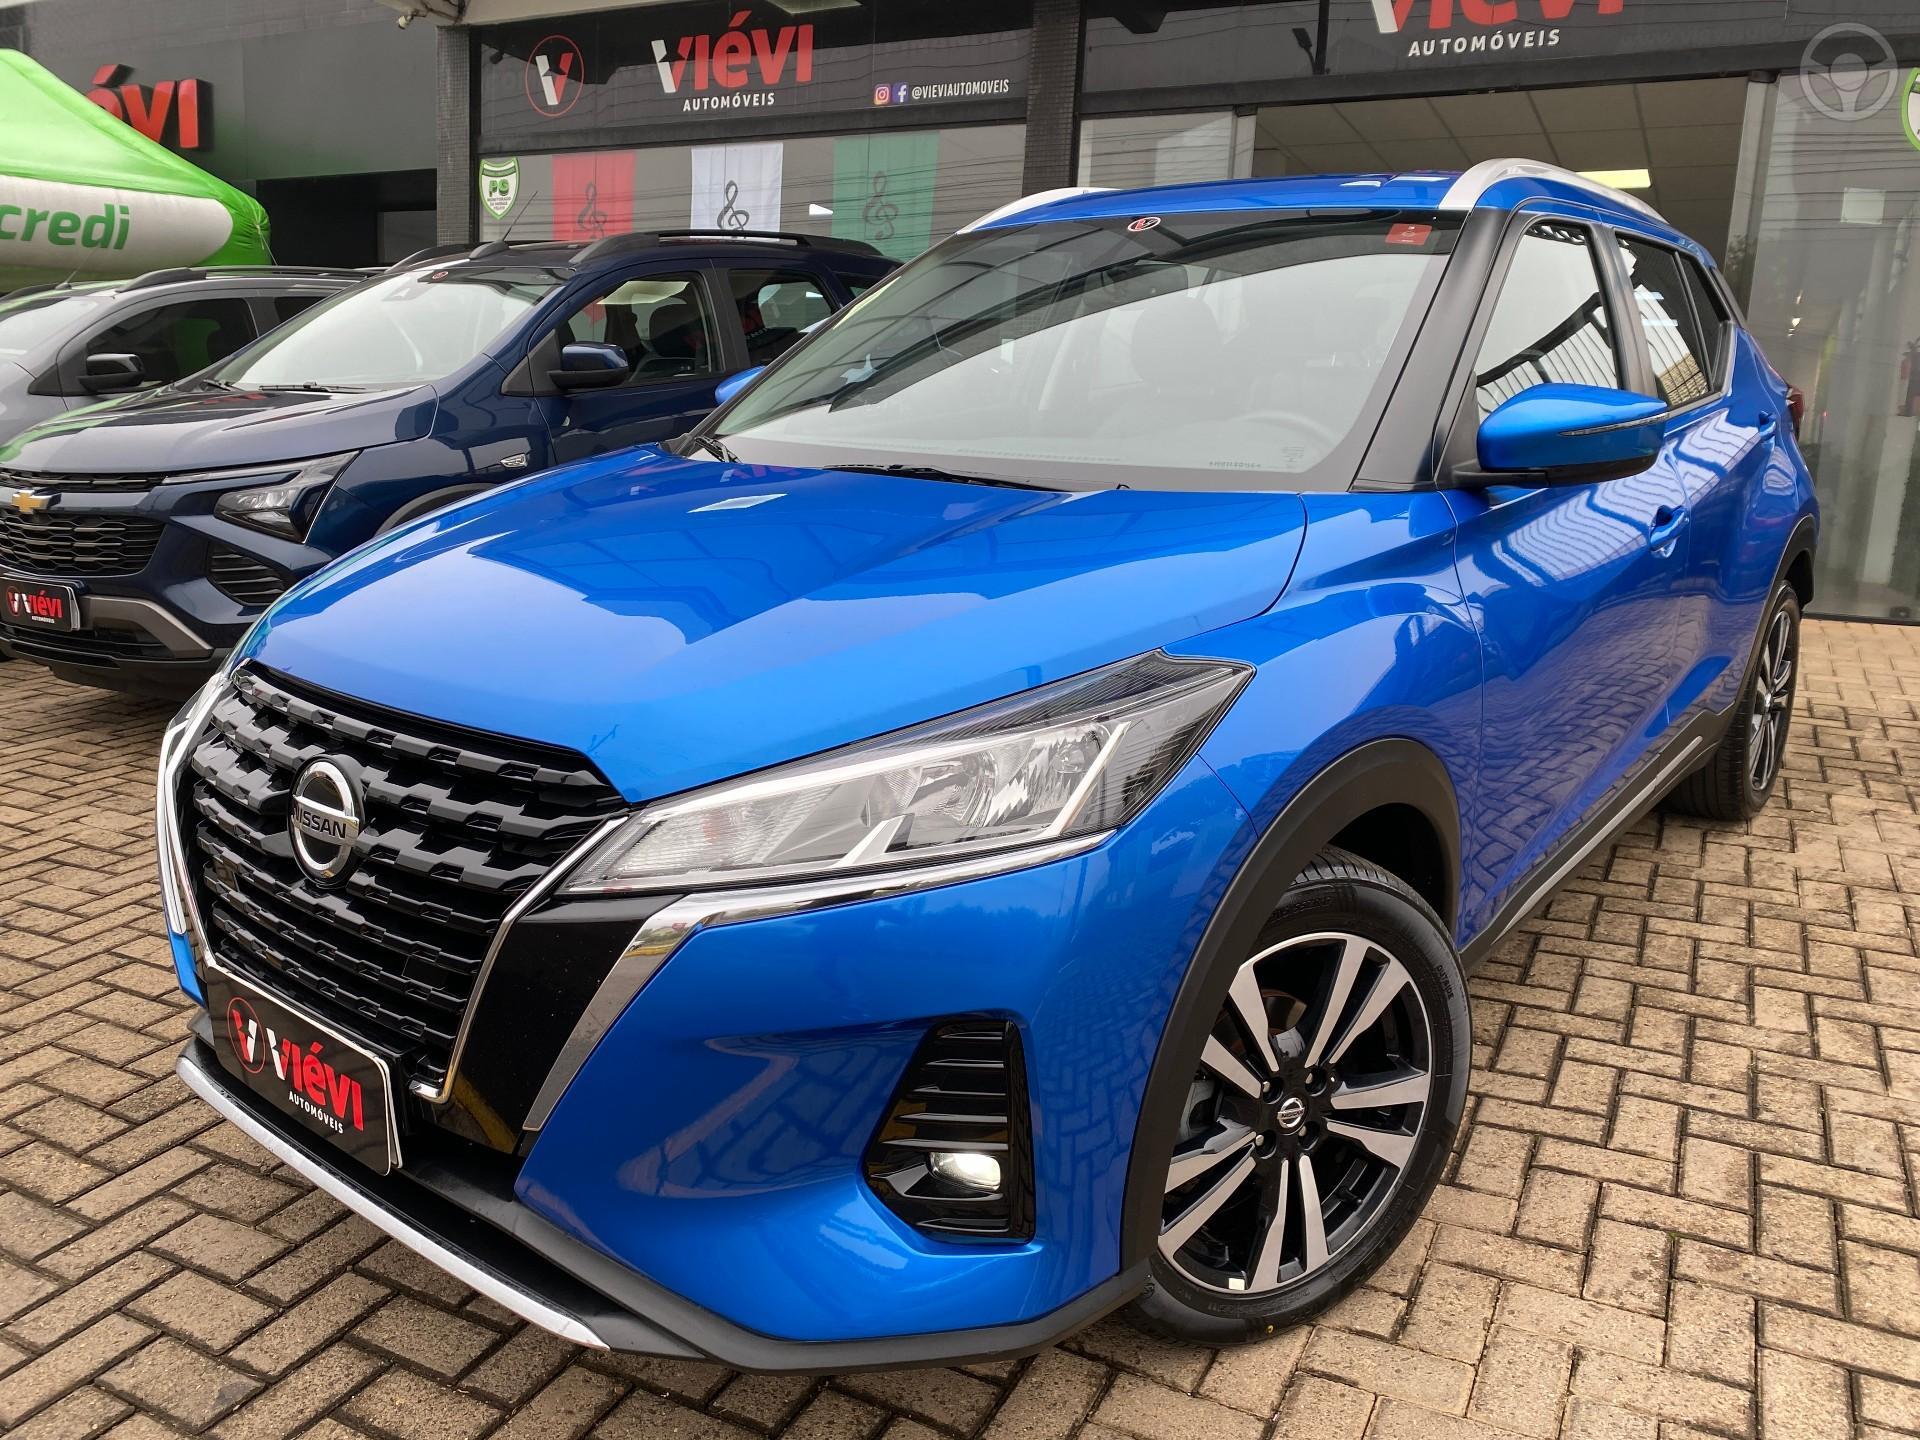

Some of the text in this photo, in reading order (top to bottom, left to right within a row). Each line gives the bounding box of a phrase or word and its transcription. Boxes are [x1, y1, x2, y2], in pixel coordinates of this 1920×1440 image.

[1408, 28, 1561, 57] AUTOMÓVEIS
[683, 92, 775, 112] AUTOMÓVEIS
[911, 78, 1010, 100] @VIEVIAUTOMOVEIS
[0, 203, 130, 250] credi
[293, 803, 348, 839] NISSAN
[288, 1090, 345, 1134] AUTOMÓVEIS
